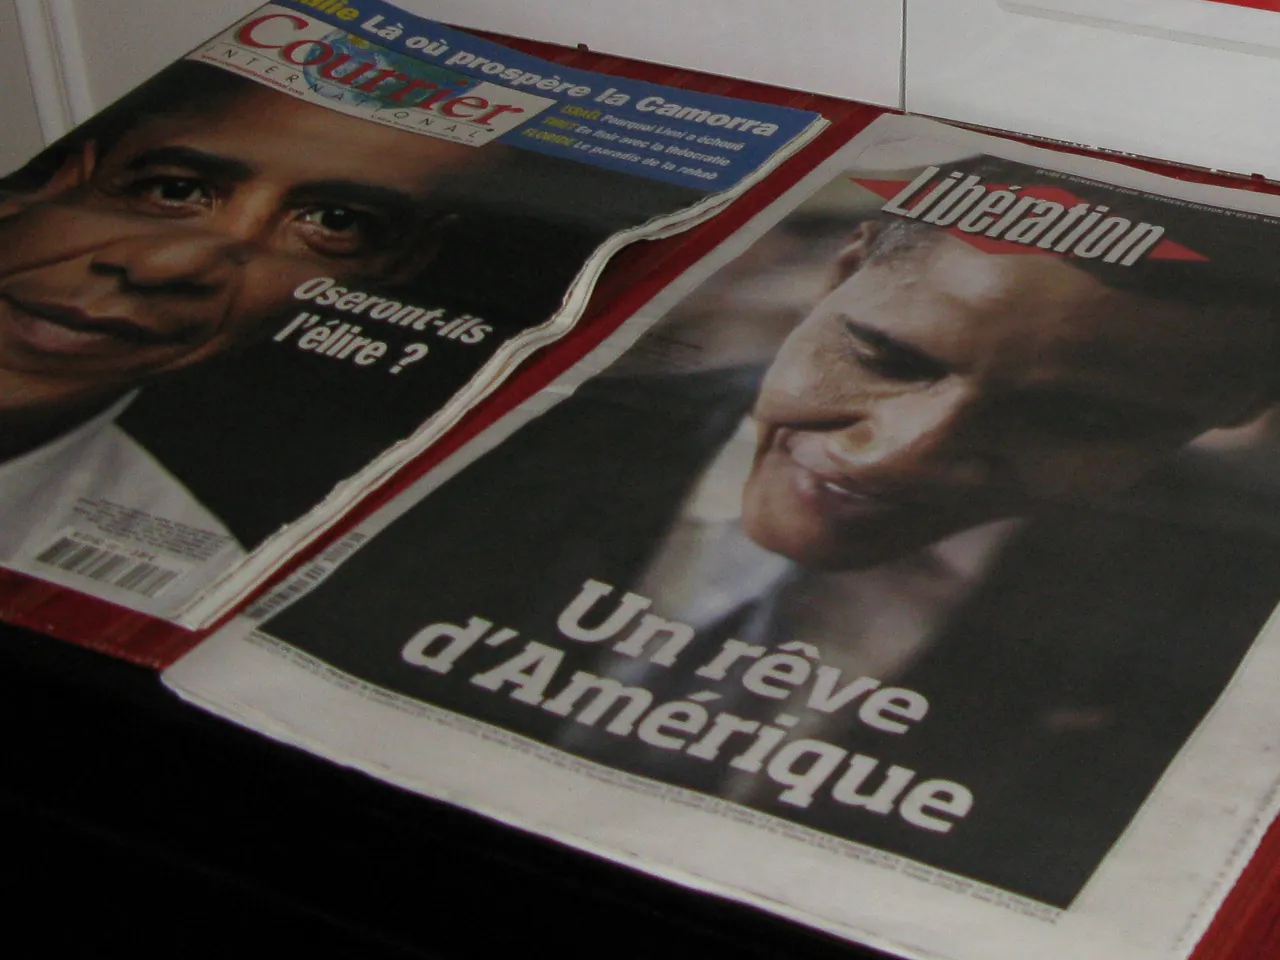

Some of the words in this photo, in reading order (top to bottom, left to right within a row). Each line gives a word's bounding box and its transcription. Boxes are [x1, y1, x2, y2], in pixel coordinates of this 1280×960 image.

[205, 44, 483, 138] INTERNATIONAL
[235, 13, 524, 126] Courrier
[360, 14, 405, 41] Là
[405, 35, 450, 57] où
[444, 50, 591, 98] prospère
[594, 87, 632, 107] la
[635, 96, 779, 138] Camorra
[572, 141, 591, 150] Le
[589, 146, 641, 163] paradis
[641, 155, 661, 167] de
[661, 160, 677, 171] la
[880, 166, 1165, 267] Libération
[273, 311, 388, 365] l'élire
[389, 342, 429, 374] ?
[293, 277, 493, 344] Oseront-ils
[556, 577, 698, 668] Un
[694, 635, 930, 734] rêve
[401, 615, 974, 833] d'Amérique
